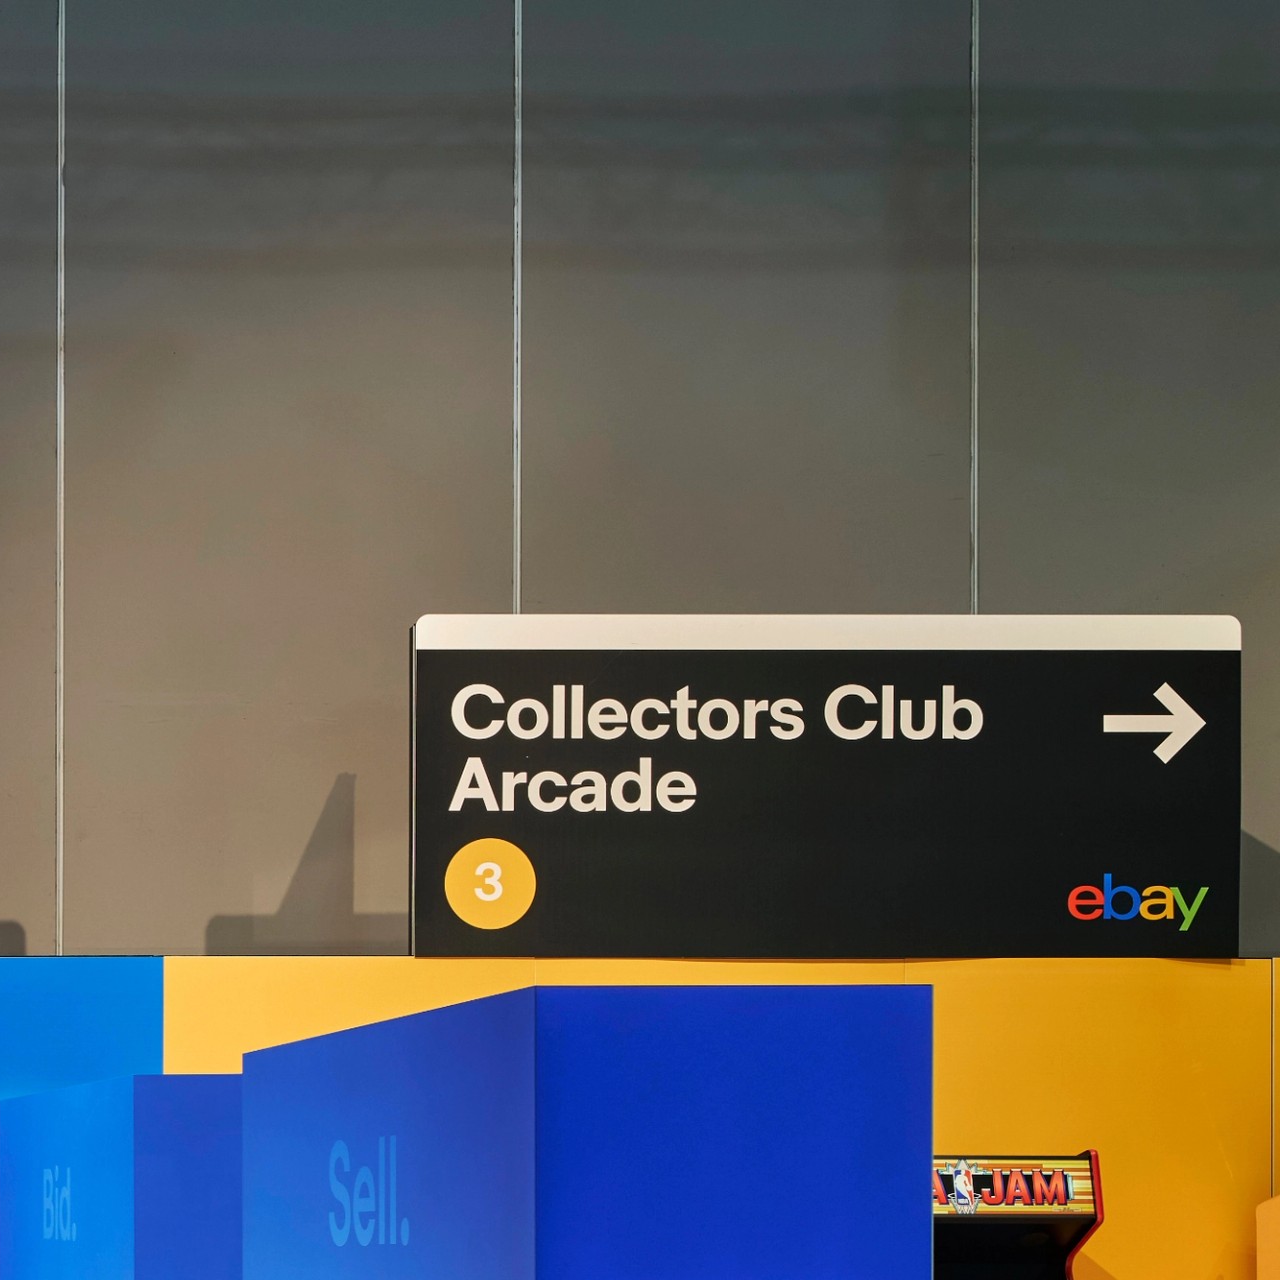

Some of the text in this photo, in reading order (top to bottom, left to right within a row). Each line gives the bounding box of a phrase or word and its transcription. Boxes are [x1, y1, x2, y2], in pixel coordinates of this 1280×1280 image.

[450, 684, 984, 740] Collectors Club
[449, 758, 697, 812] Arcade
[473, 862, 503, 902] 3
[1067, 874, 1209, 931] ebay
[43, 1165, 77, 1242] Bid.
[329, 1135, 410, 1247] Sell.
[981, 1168, 1068, 1206] JAM
